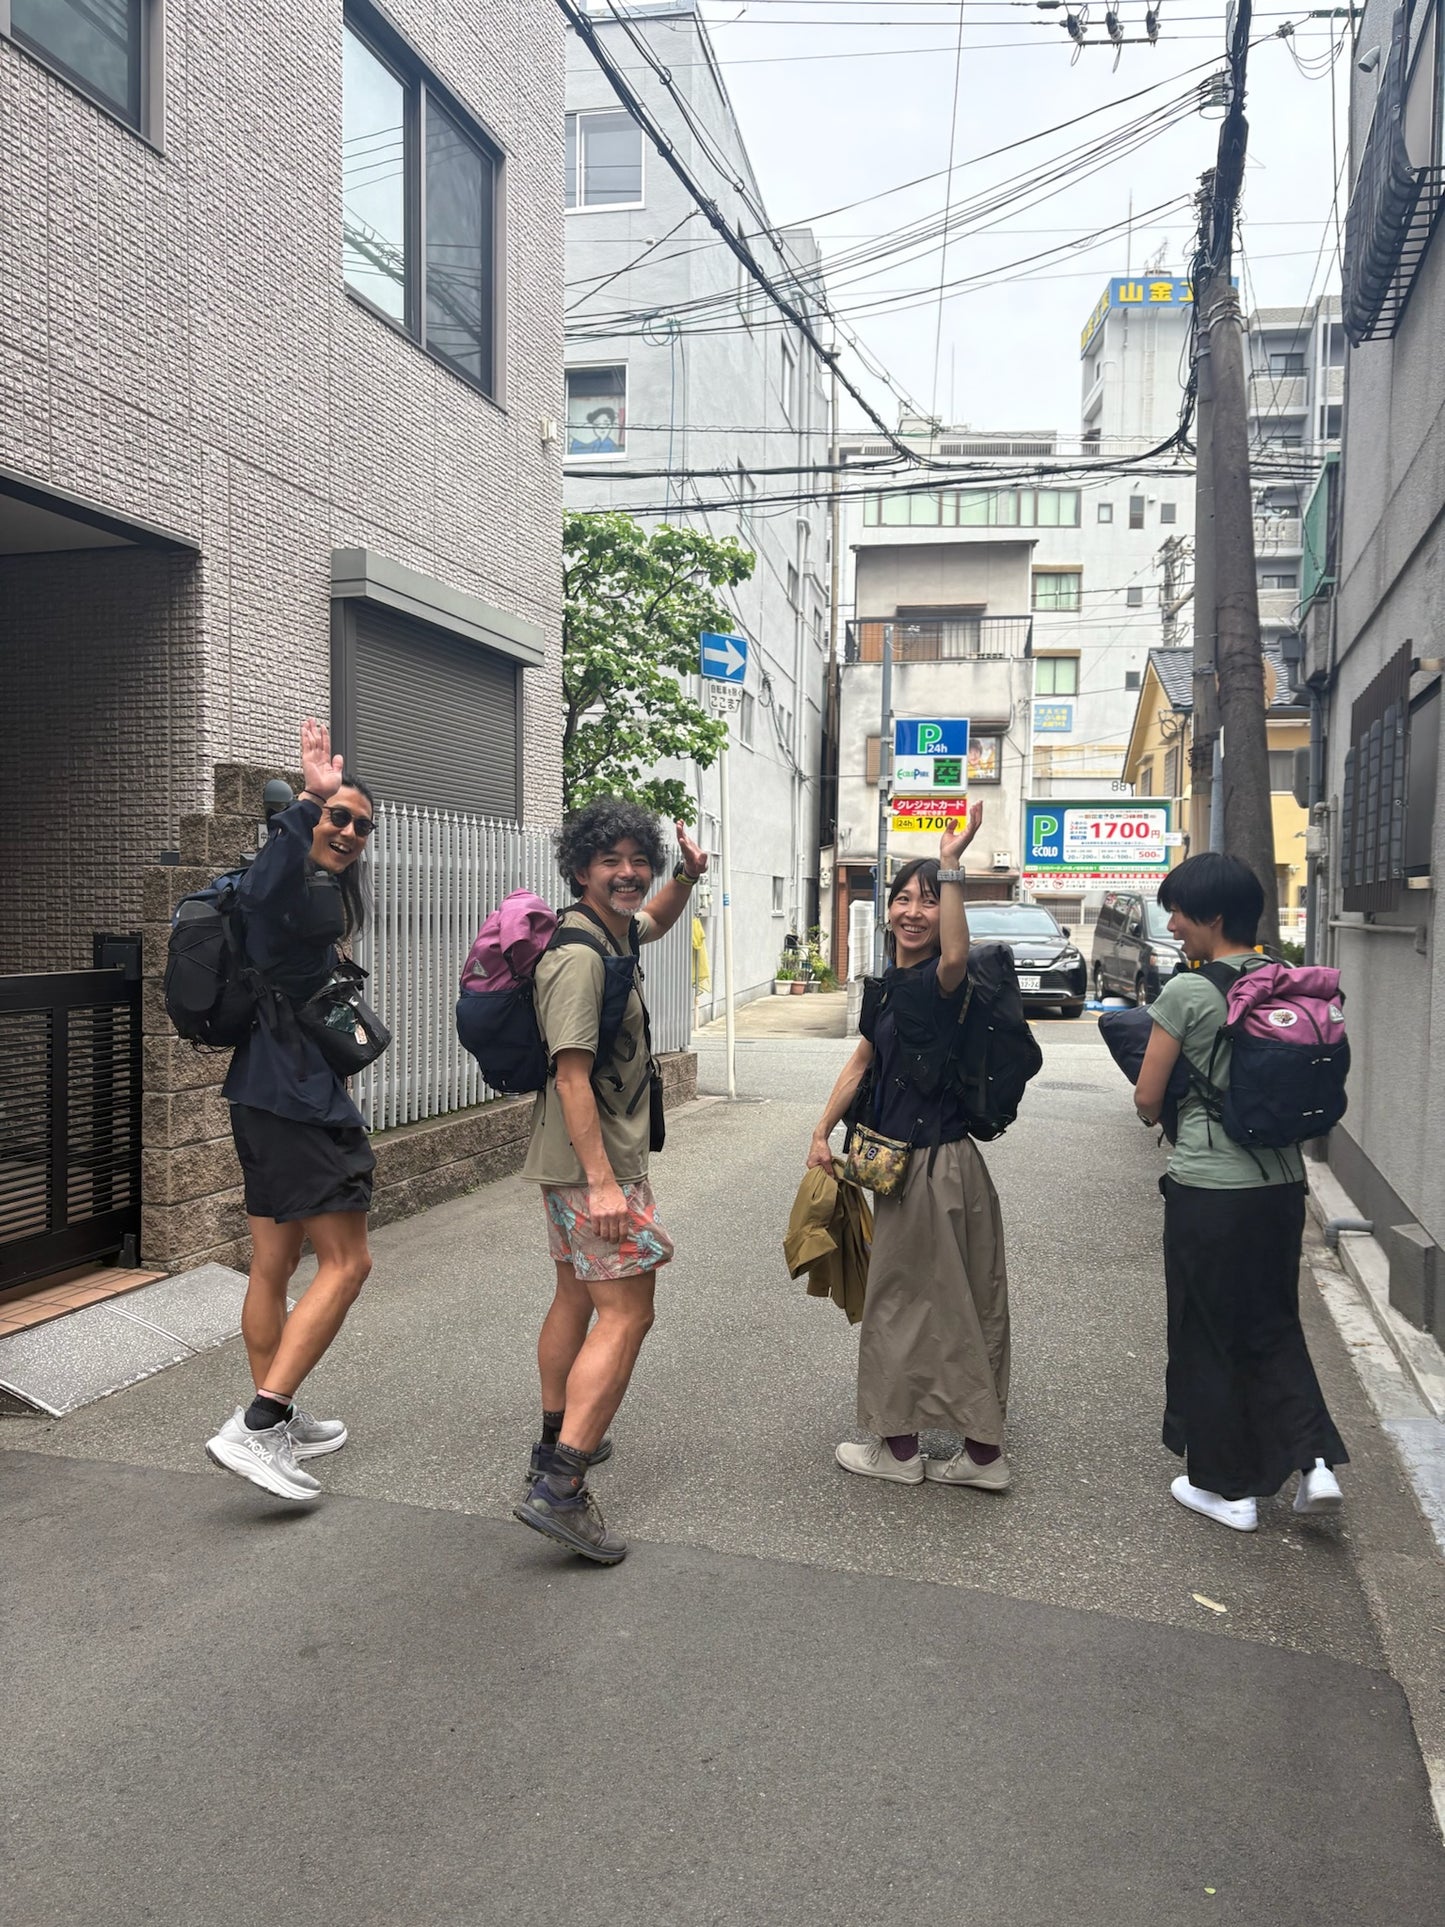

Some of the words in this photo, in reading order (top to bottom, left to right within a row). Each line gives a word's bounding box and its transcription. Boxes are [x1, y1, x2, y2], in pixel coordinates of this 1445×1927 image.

[917, 723, 943, 754] P
[927, 743, 948, 754] 24h
[933, 758, 962, 786] 空
[897, 800, 964, 810] クレジットカード
[898, 819, 913, 827] 24h
[916, 817, 961, 829] 1700
[1032, 815, 1059, 847] P
[244, 1436, 274, 1465] HOKA
